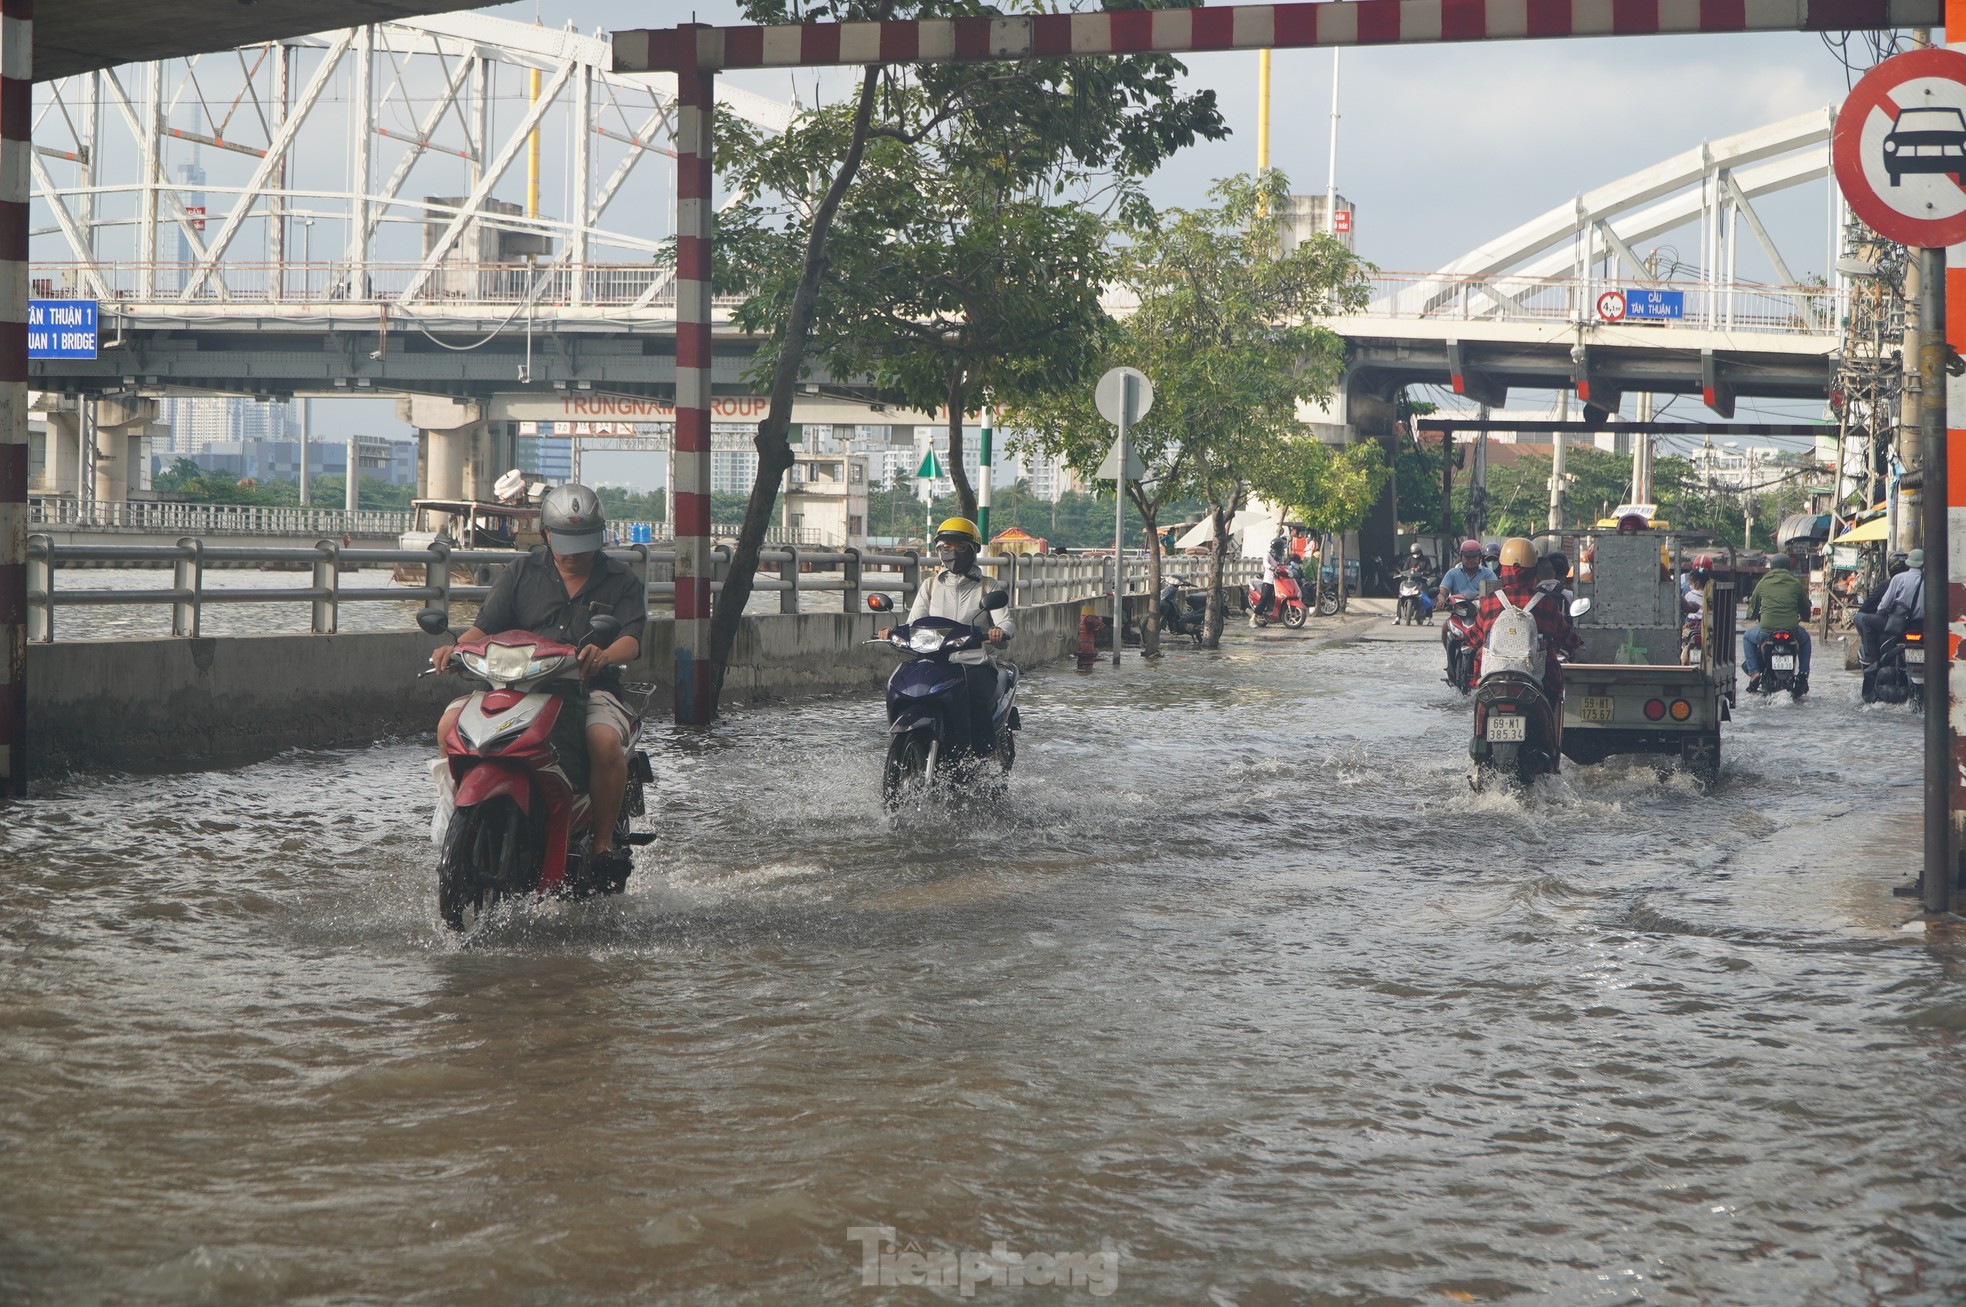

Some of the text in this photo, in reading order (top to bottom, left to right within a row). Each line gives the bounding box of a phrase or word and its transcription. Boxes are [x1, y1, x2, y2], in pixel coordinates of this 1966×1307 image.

[1631, 302, 1678, 317] TÂN THUẬN 1
[28, 305, 92, 328] ÂN THUẬN 1
[28, 332, 95, 350] UAN 1 BRIDGE
[711, 397, 766, 417] ROUP
[1584, 697, 1609, 709] 59-N1
[1582, 708, 1611, 720] 175.67
[1493, 718, 1520, 729] 69-N1
[1490, 729, 1523, 740] 385.34
